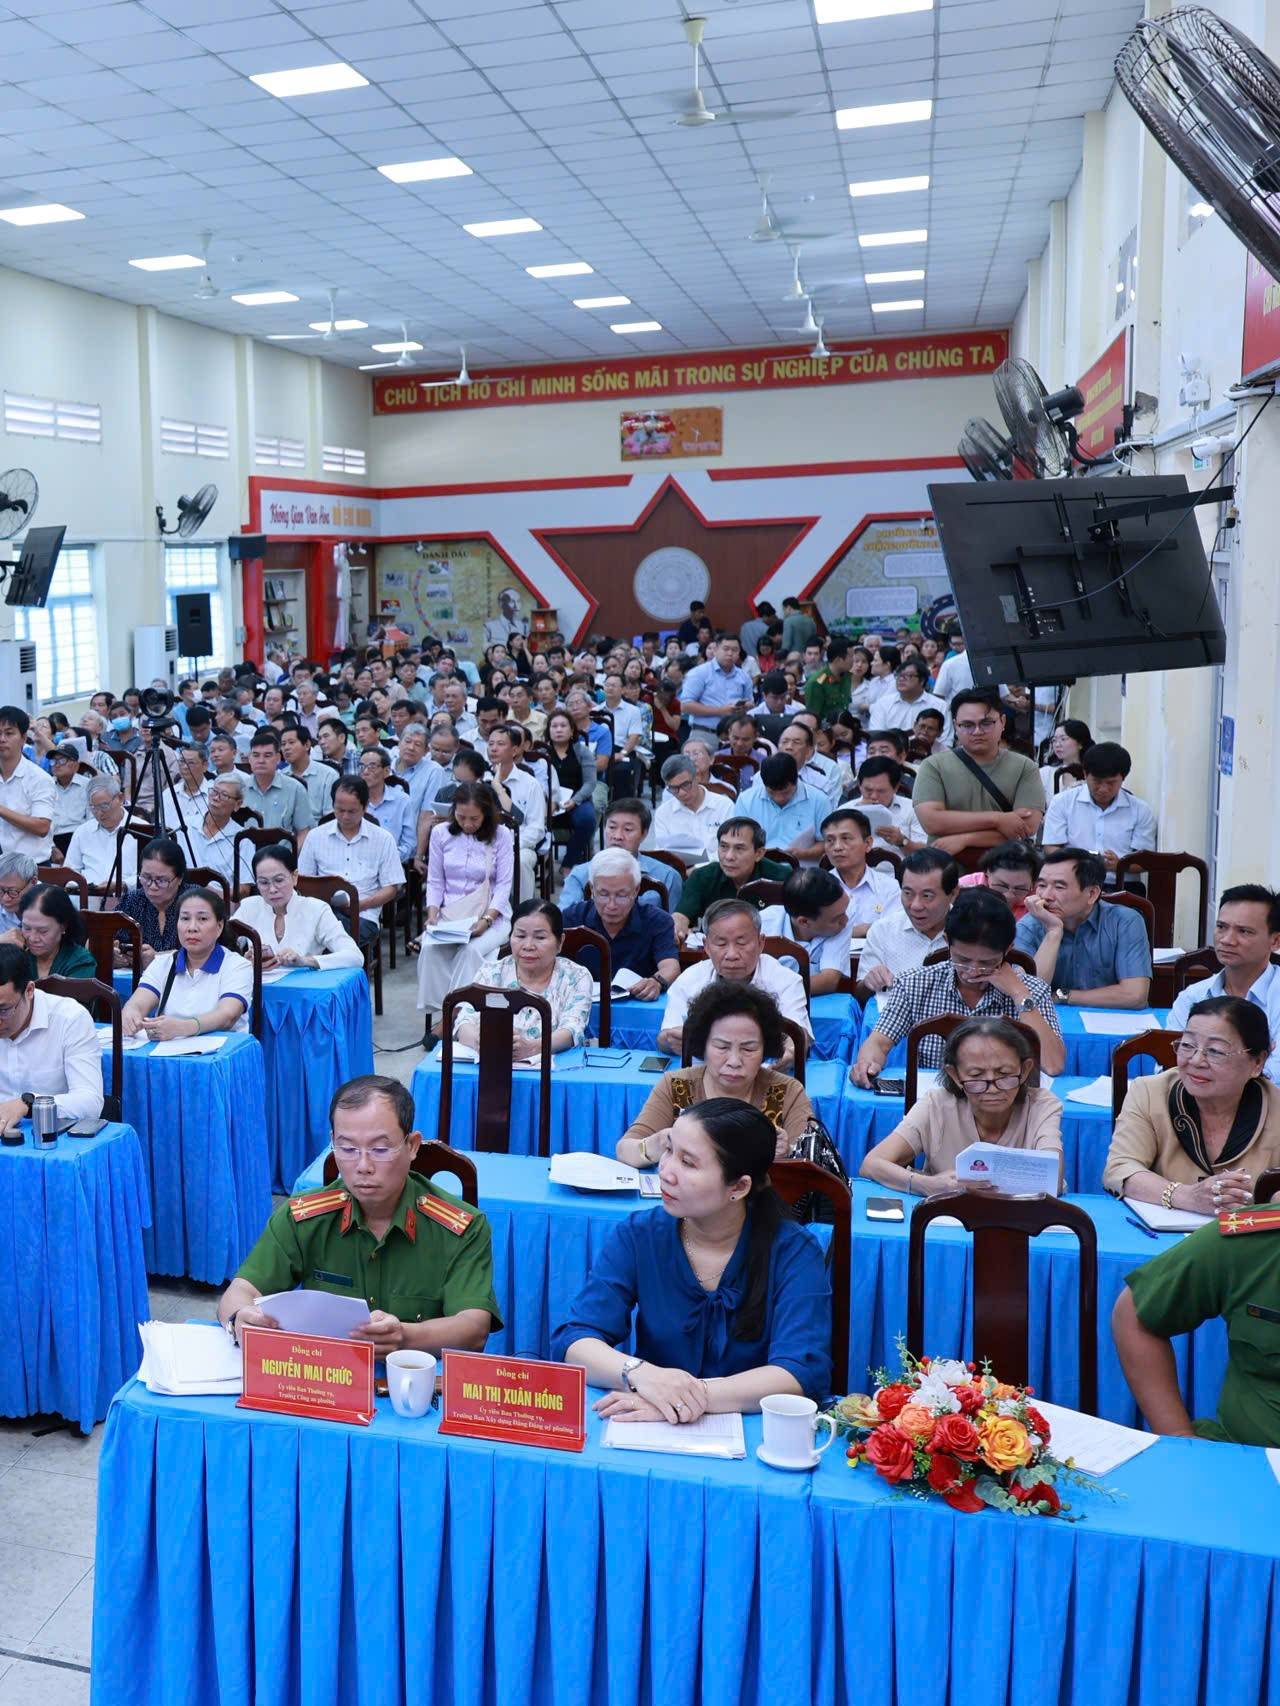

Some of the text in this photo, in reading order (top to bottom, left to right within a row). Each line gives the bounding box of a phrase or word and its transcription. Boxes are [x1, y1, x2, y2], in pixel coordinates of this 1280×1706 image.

[384, 382, 417, 406] CHỦ
[425, 384, 462, 406] TỊCH
[531, 376, 576, 396] MINH
[582, 368, 629, 392] SỐNG
[635, 366, 669, 388] MÃI
[674, 364, 735, 386] TRONG
[742, 360, 767, 383] SỰ
[773, 357, 843, 380] NGHIỆP
[850, 350, 888, 373] CỦA
[895, 345, 963, 370] CHÚNG
[970, 345, 995, 365] TA
[292, 1345, 322, 1357] Đồng chí
[262, 1357, 353, 1385] NGUYỄN MAI CHỨC
[496, 1368, 529, 1380] Đồng chí
[463, 1383, 482, 1400] MAI
[485, 1386, 501, 1406] THỊ
[504, 1387, 532, 1407] XUÂN
